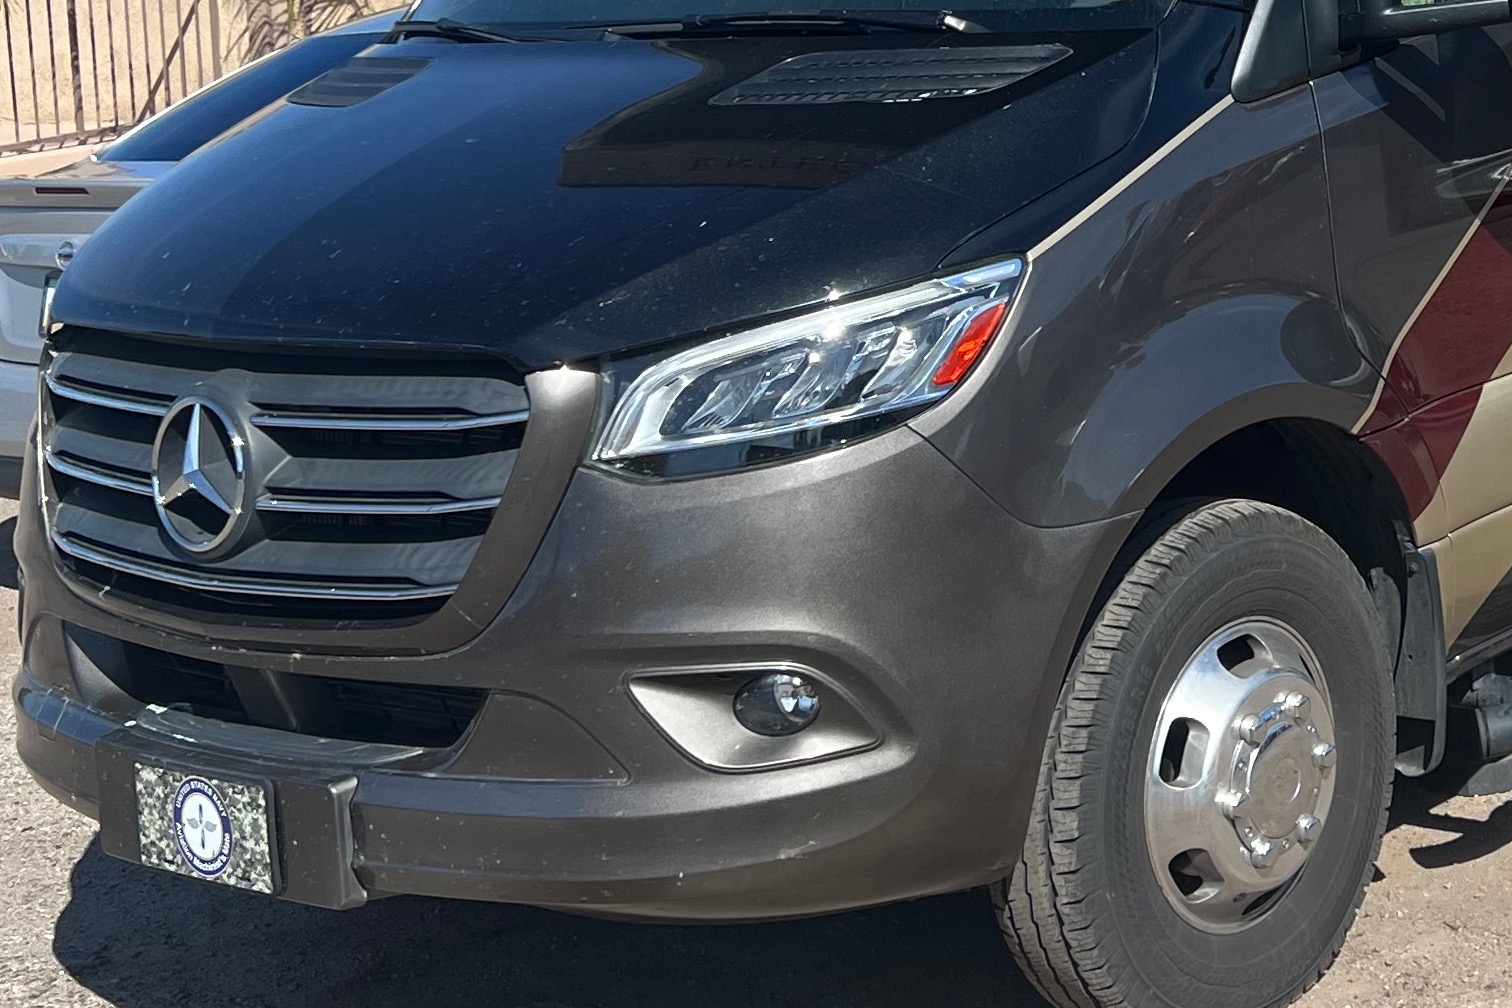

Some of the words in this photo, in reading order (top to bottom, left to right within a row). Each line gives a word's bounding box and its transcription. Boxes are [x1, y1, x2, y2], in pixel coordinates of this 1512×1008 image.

[175, 783, 191, 809] UNITED
[190, 780, 213, 796] STATES
[212, 793, 227, 817] NAVY
